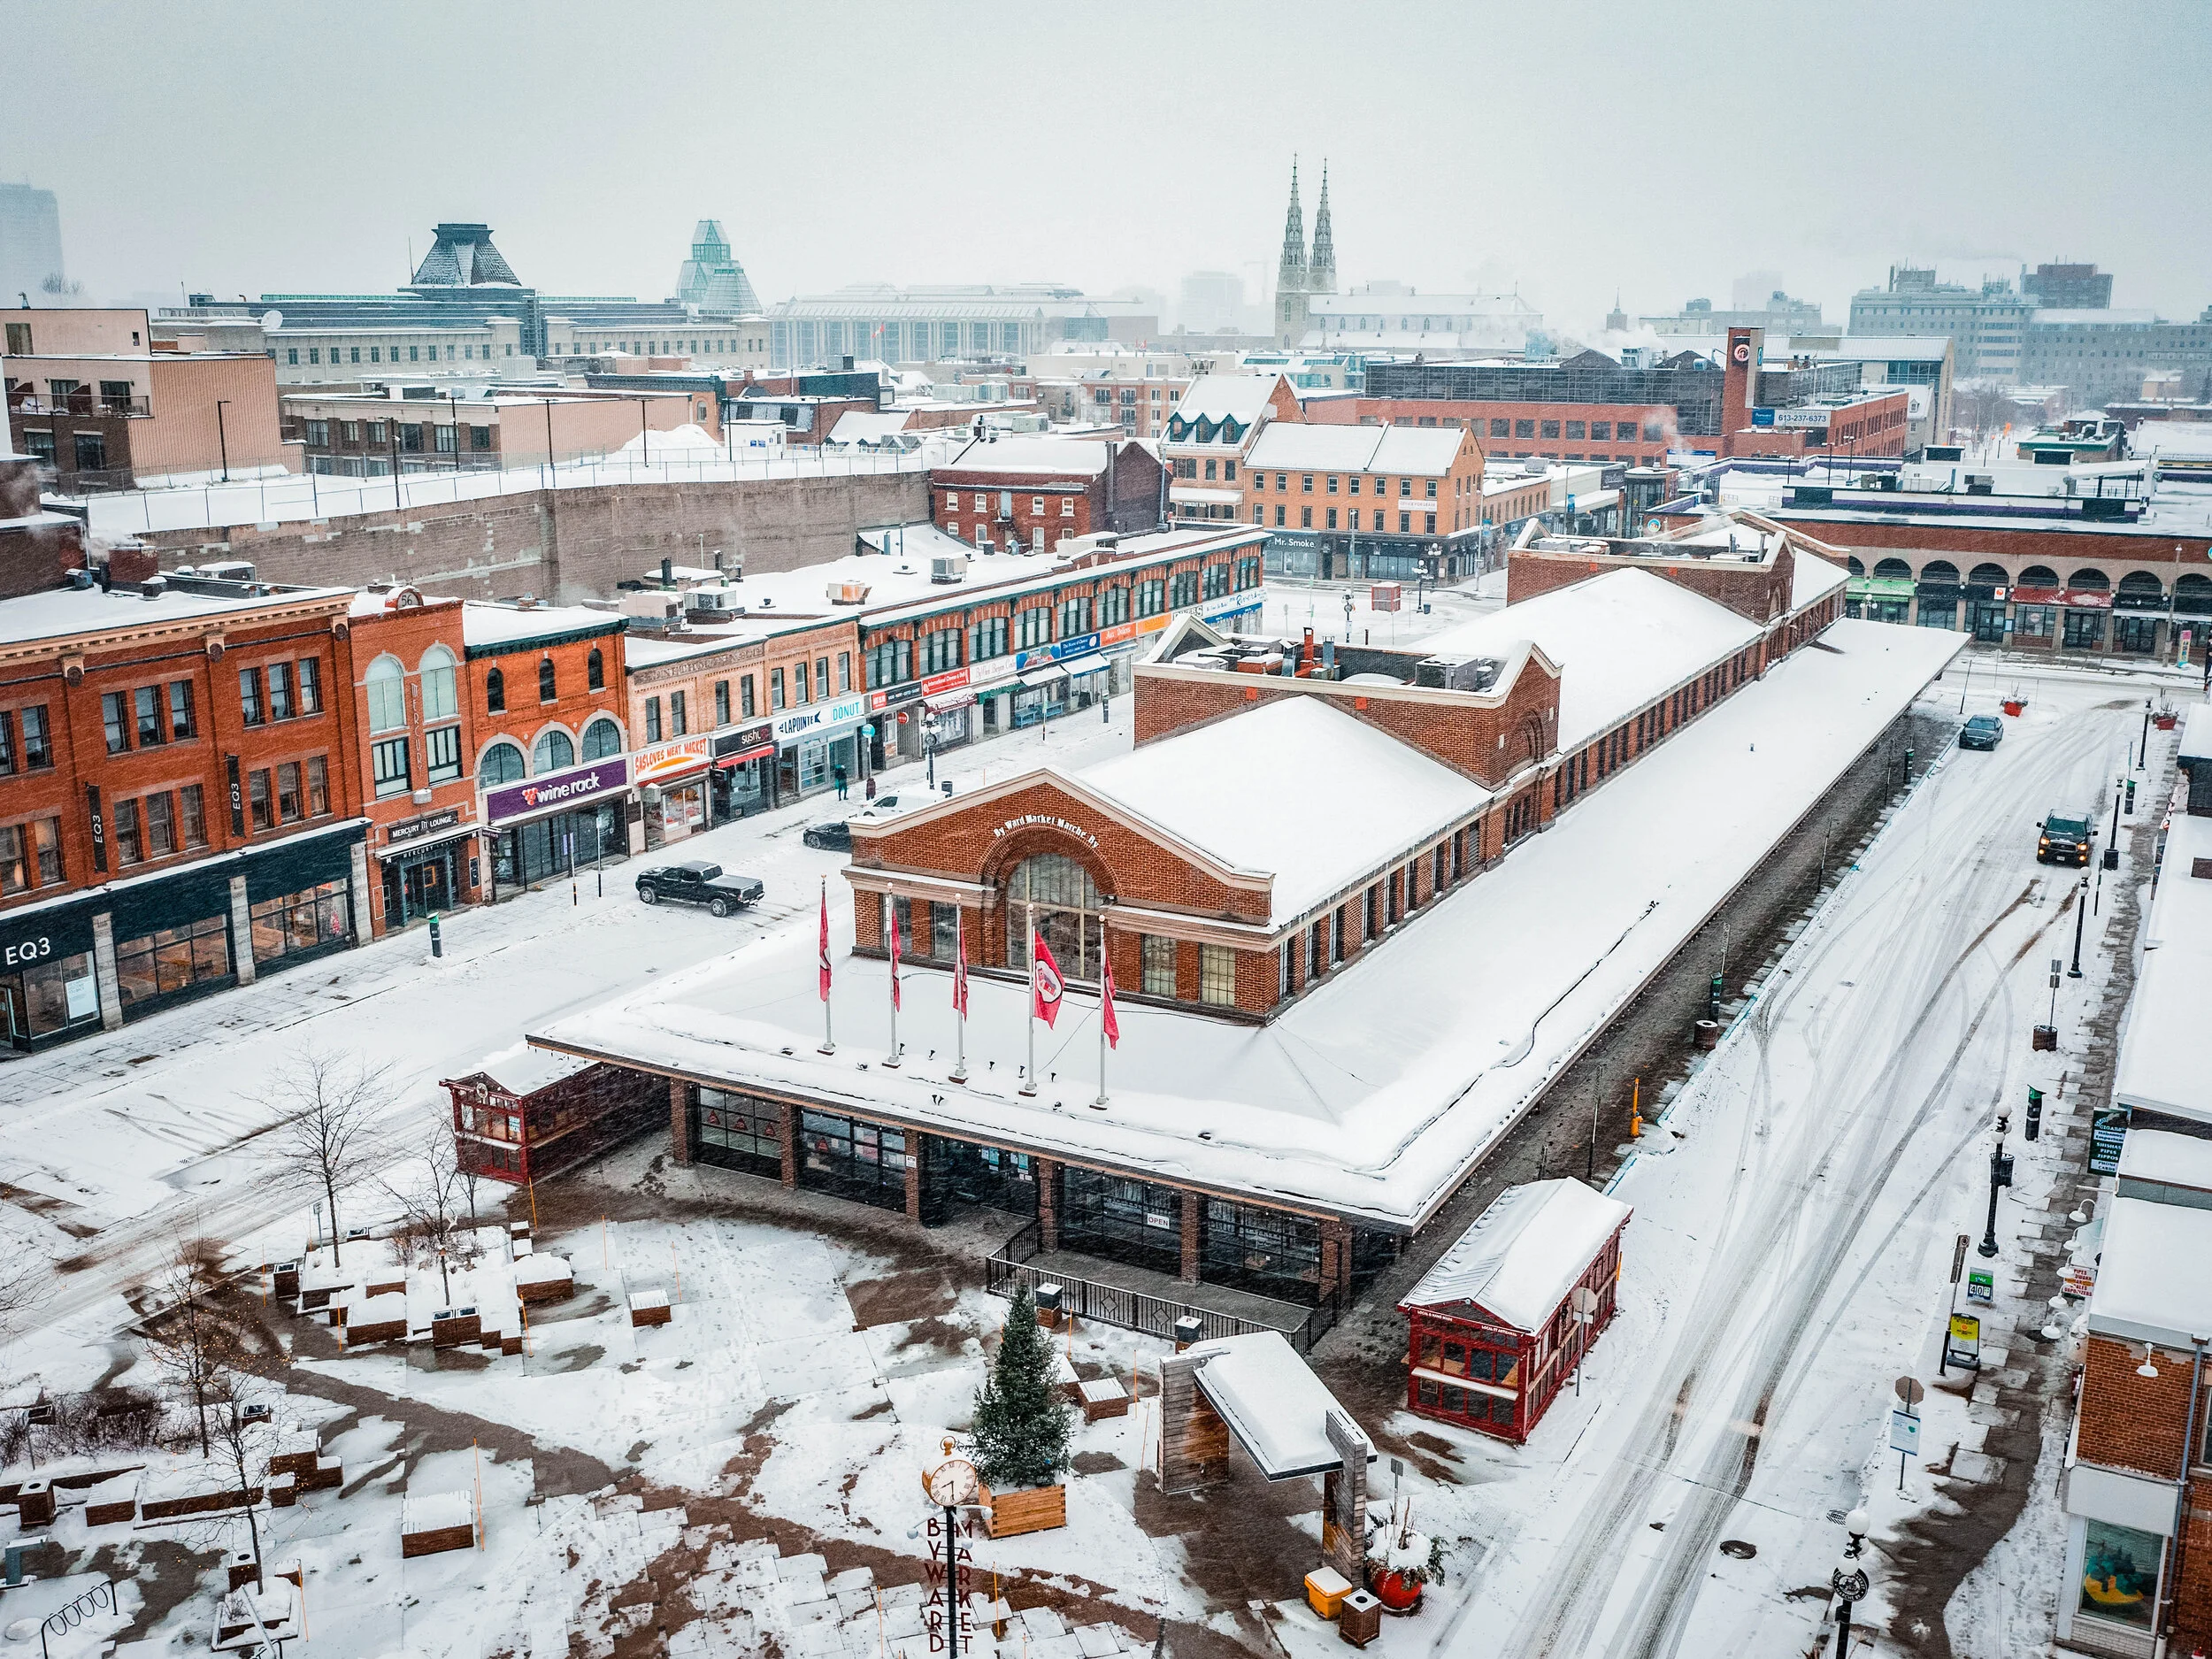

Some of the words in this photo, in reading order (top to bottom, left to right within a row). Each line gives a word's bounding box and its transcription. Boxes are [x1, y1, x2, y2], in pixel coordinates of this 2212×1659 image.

[1274, 537, 1286, 546] Mr.
[401, 595, 413, 607] 56
[411, 682, 422, 771] MERCURY
[785, 716, 814, 733] LAPOINTE
[833, 702, 860, 721] DONUT
[741, 728, 761, 745] sushi
[635, 749, 664, 775] SASLOVES
[667, 745, 681, 758] MEAT
[684, 738, 707, 755] MARKET
[231, 783, 241, 810] EQ3
[537, 784, 569, 803] wine
[571, 772, 601, 794] rack
[92, 814, 103, 844] EQ3
[392, 824, 419, 837] MERCURY
[430, 815, 452, 827] LOUNGE
[993, 827, 1006, 837] By
[1004, 816, 1025, 830] Ward
[1025, 814, 1055, 824] Market
[1088, 834, 1099, 849] By
[5, 937, 51, 966] EQ3
[1148, 1217, 1168, 1226] OPEN
[956, 1520, 973, 1654] MARKET
